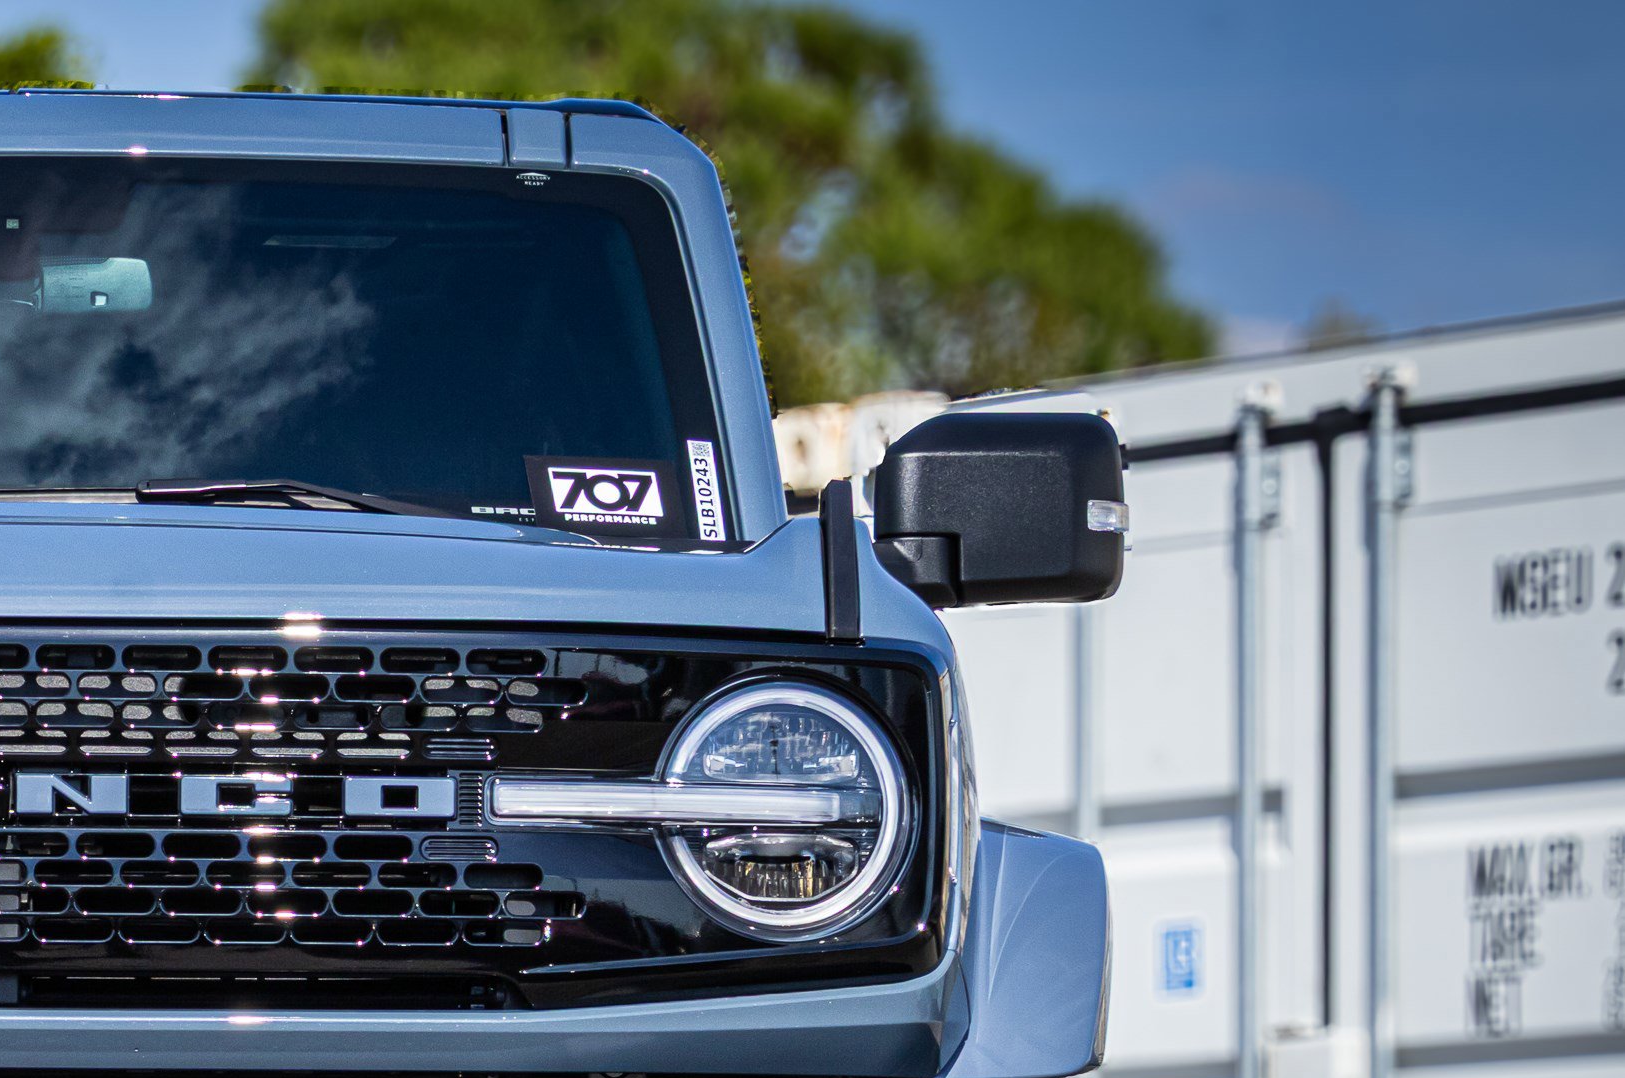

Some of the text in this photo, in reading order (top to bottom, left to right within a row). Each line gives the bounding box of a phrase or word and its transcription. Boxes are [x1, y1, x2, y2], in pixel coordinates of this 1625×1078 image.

[551, 470, 654, 512] 707
[693, 458, 718, 538] SLB10243
[564, 513, 657, 525] PERFORMANCE
